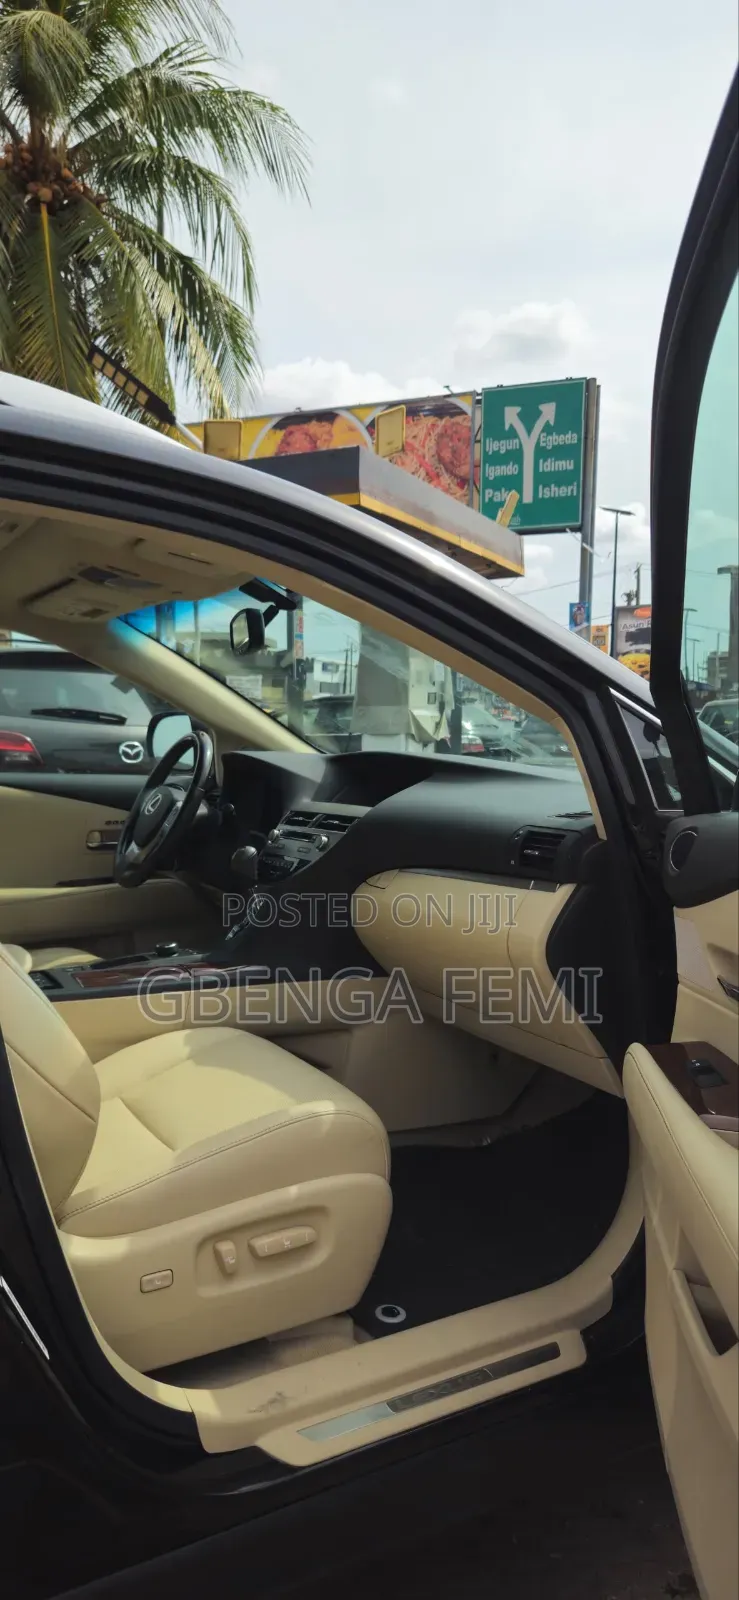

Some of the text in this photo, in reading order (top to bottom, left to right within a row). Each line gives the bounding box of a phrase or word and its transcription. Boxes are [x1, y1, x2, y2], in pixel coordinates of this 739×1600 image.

[486, 438, 519, 455] Ijegun
[540, 431, 577, 449] Egbeda
[485, 462, 518, 480] Igando
[539, 459, 574, 472] Idimu
[485, 488, 514, 503] Pak
[538, 482, 577, 498] Isheri
